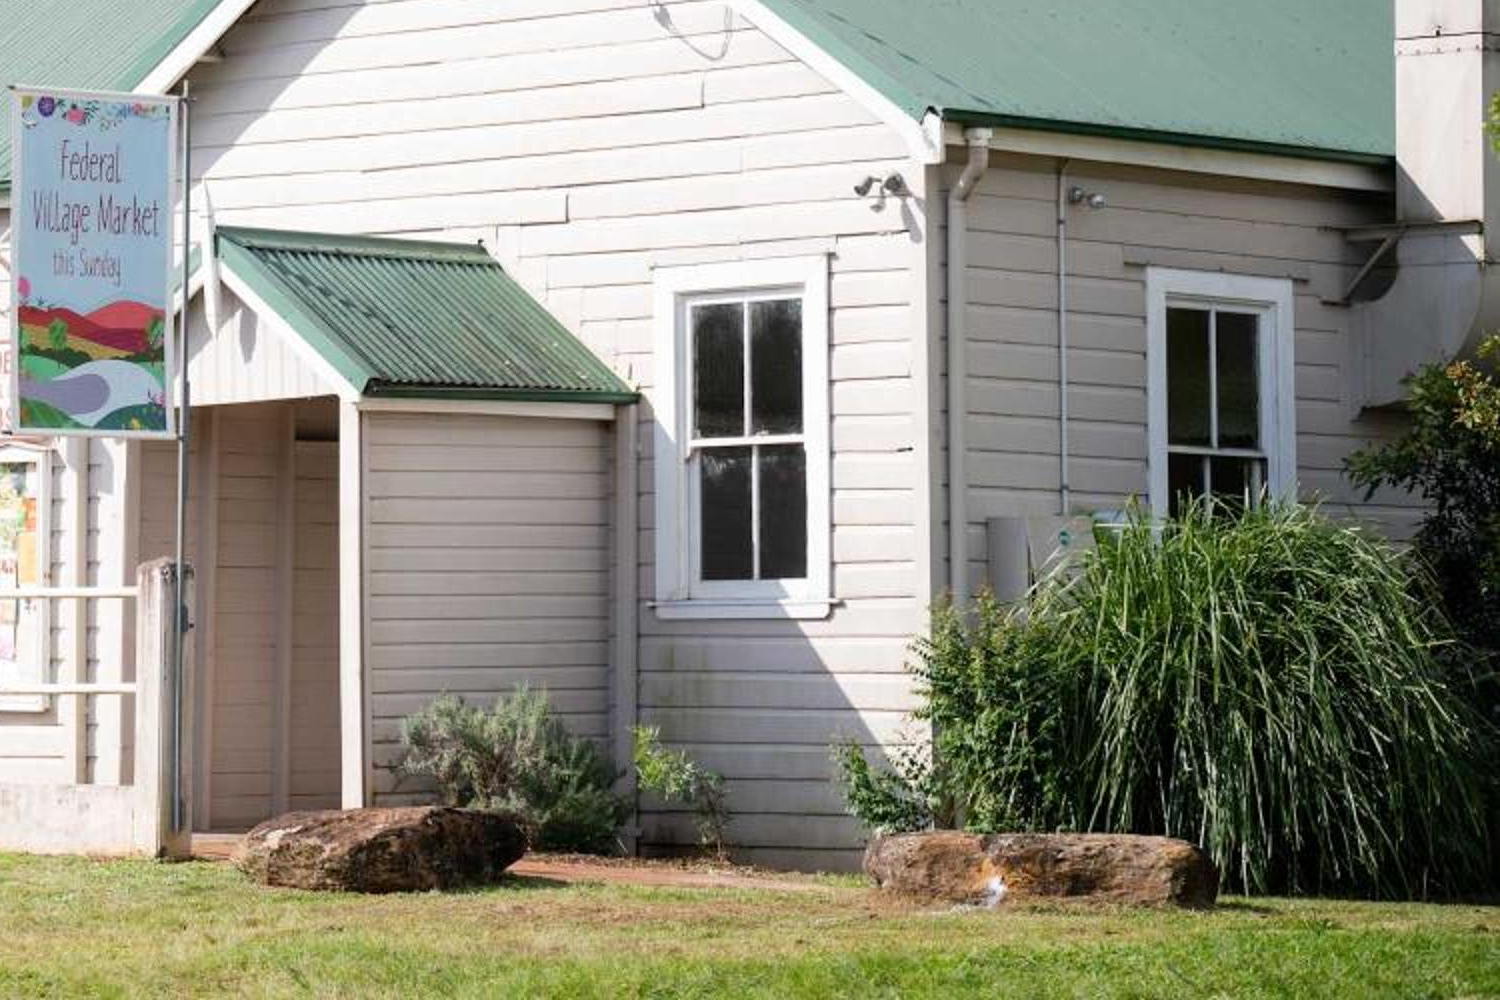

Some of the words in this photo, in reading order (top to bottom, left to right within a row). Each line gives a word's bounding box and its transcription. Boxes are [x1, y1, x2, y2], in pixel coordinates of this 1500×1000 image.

[61, 139, 122, 183] Federal
[33, 190, 90, 245] Village
[98, 194, 160, 237] Market
[53, 250, 74, 276] this
[80, 248, 121, 287] Sunday
